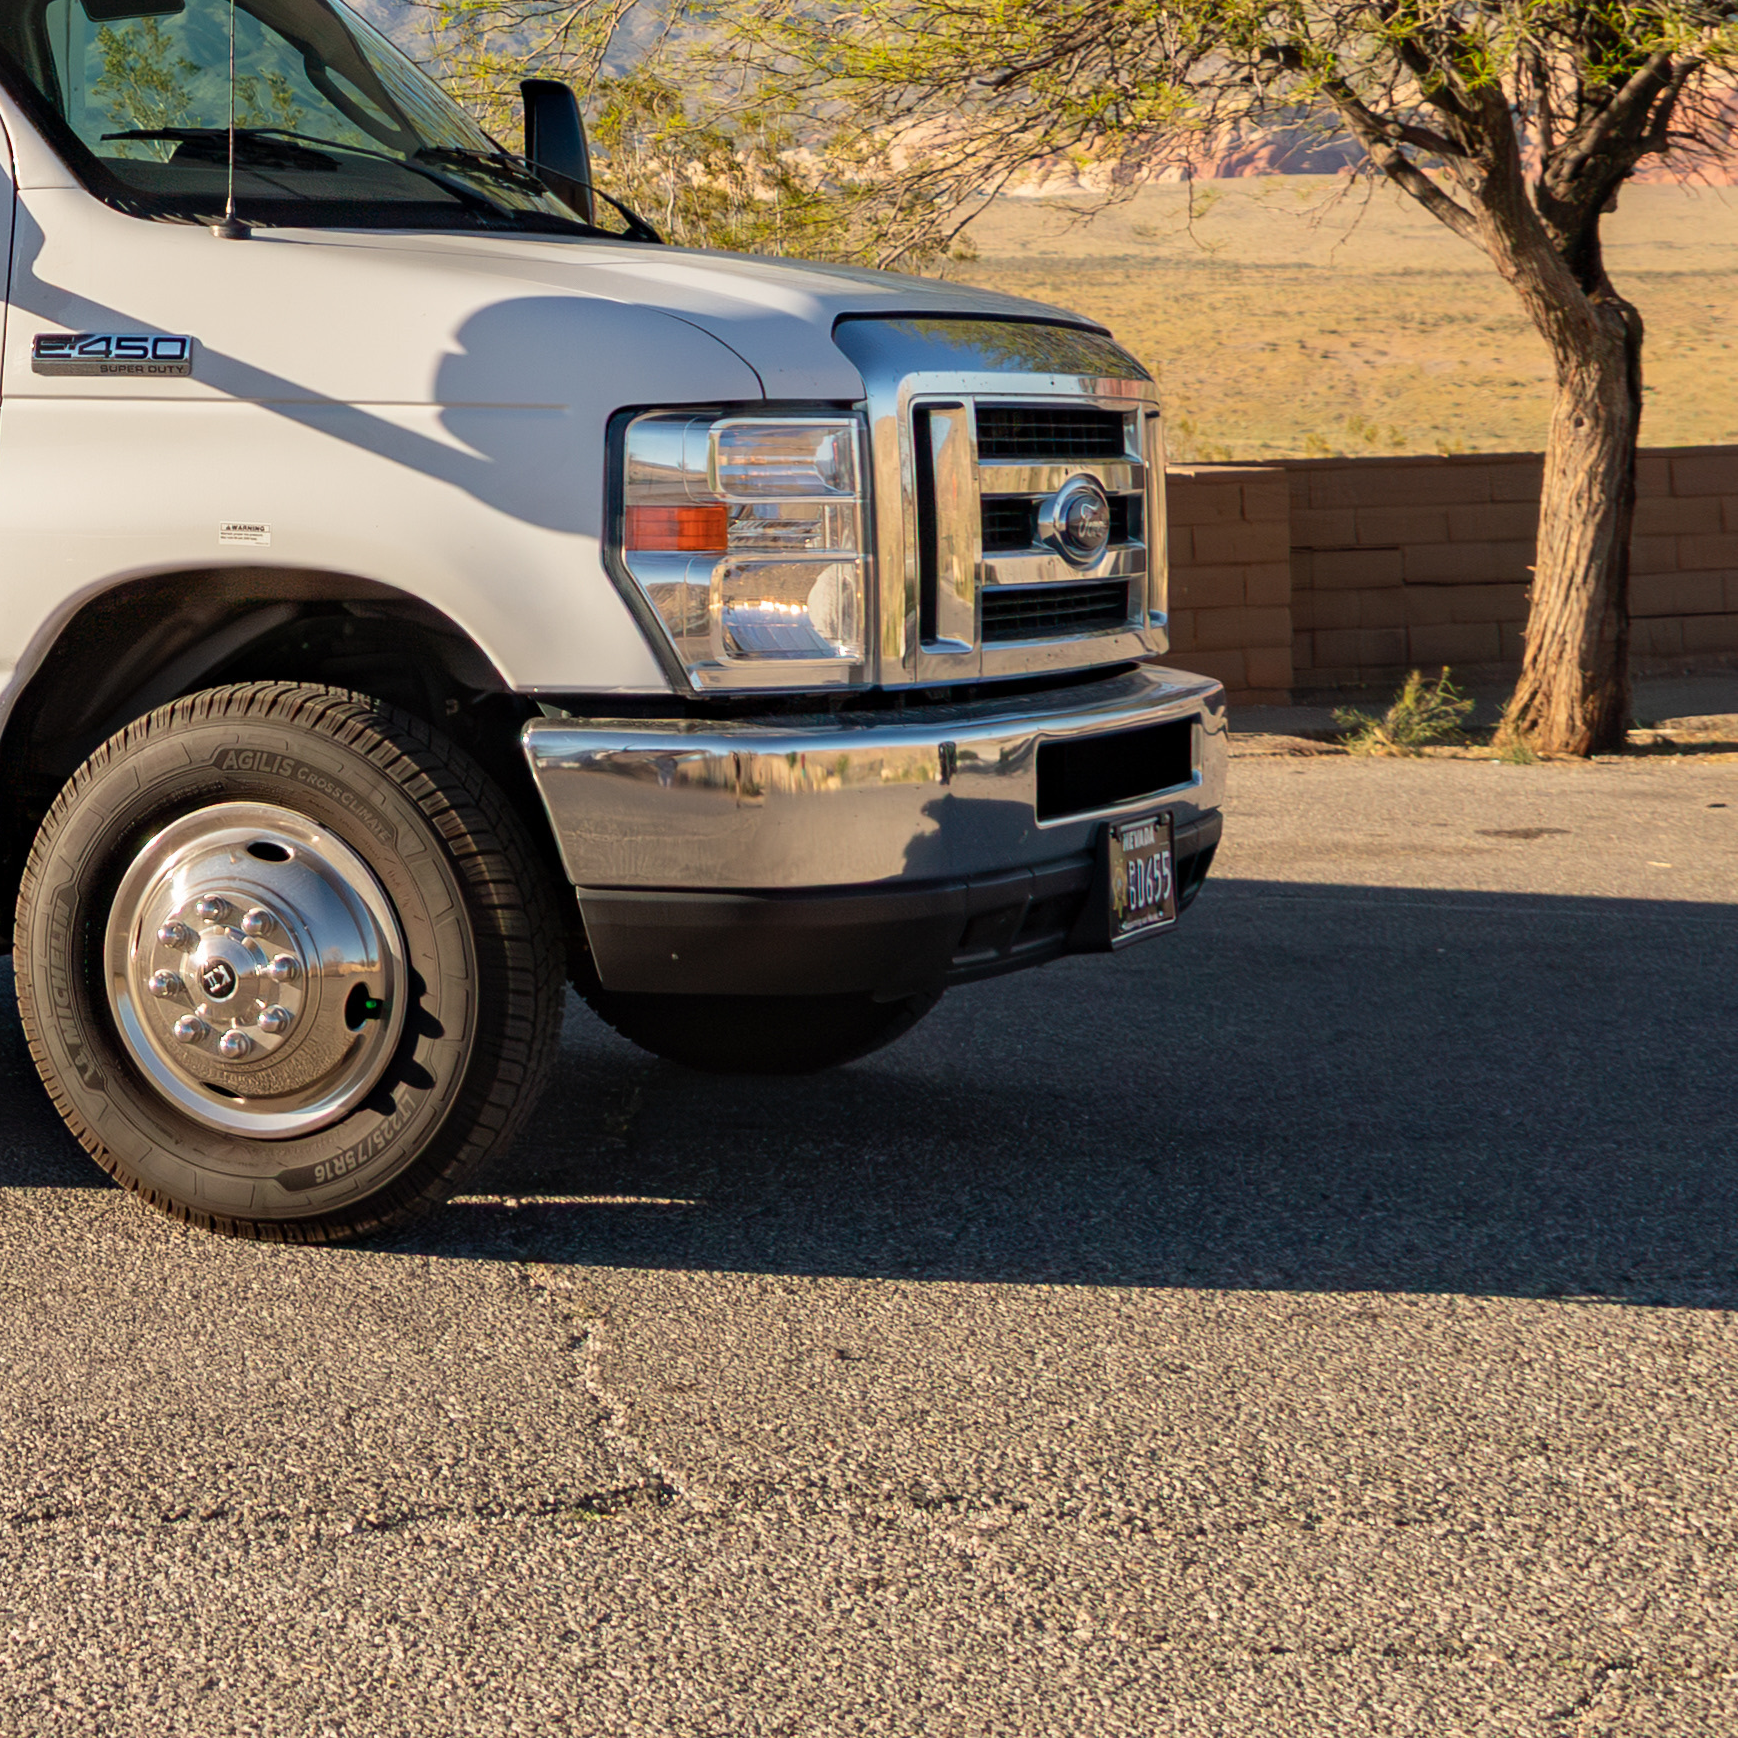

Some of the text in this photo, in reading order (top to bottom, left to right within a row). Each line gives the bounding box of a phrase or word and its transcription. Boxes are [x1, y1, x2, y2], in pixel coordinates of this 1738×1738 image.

[35, 335, 188, 359] E-450
[99, 364, 184, 373] SUPER DUTY
[222, 750, 392, 842] AGILIS CROSSCLIMATE
[1122, 824, 1156, 852] NEVADA
[50, 897, 83, 1046] MICHELIN
